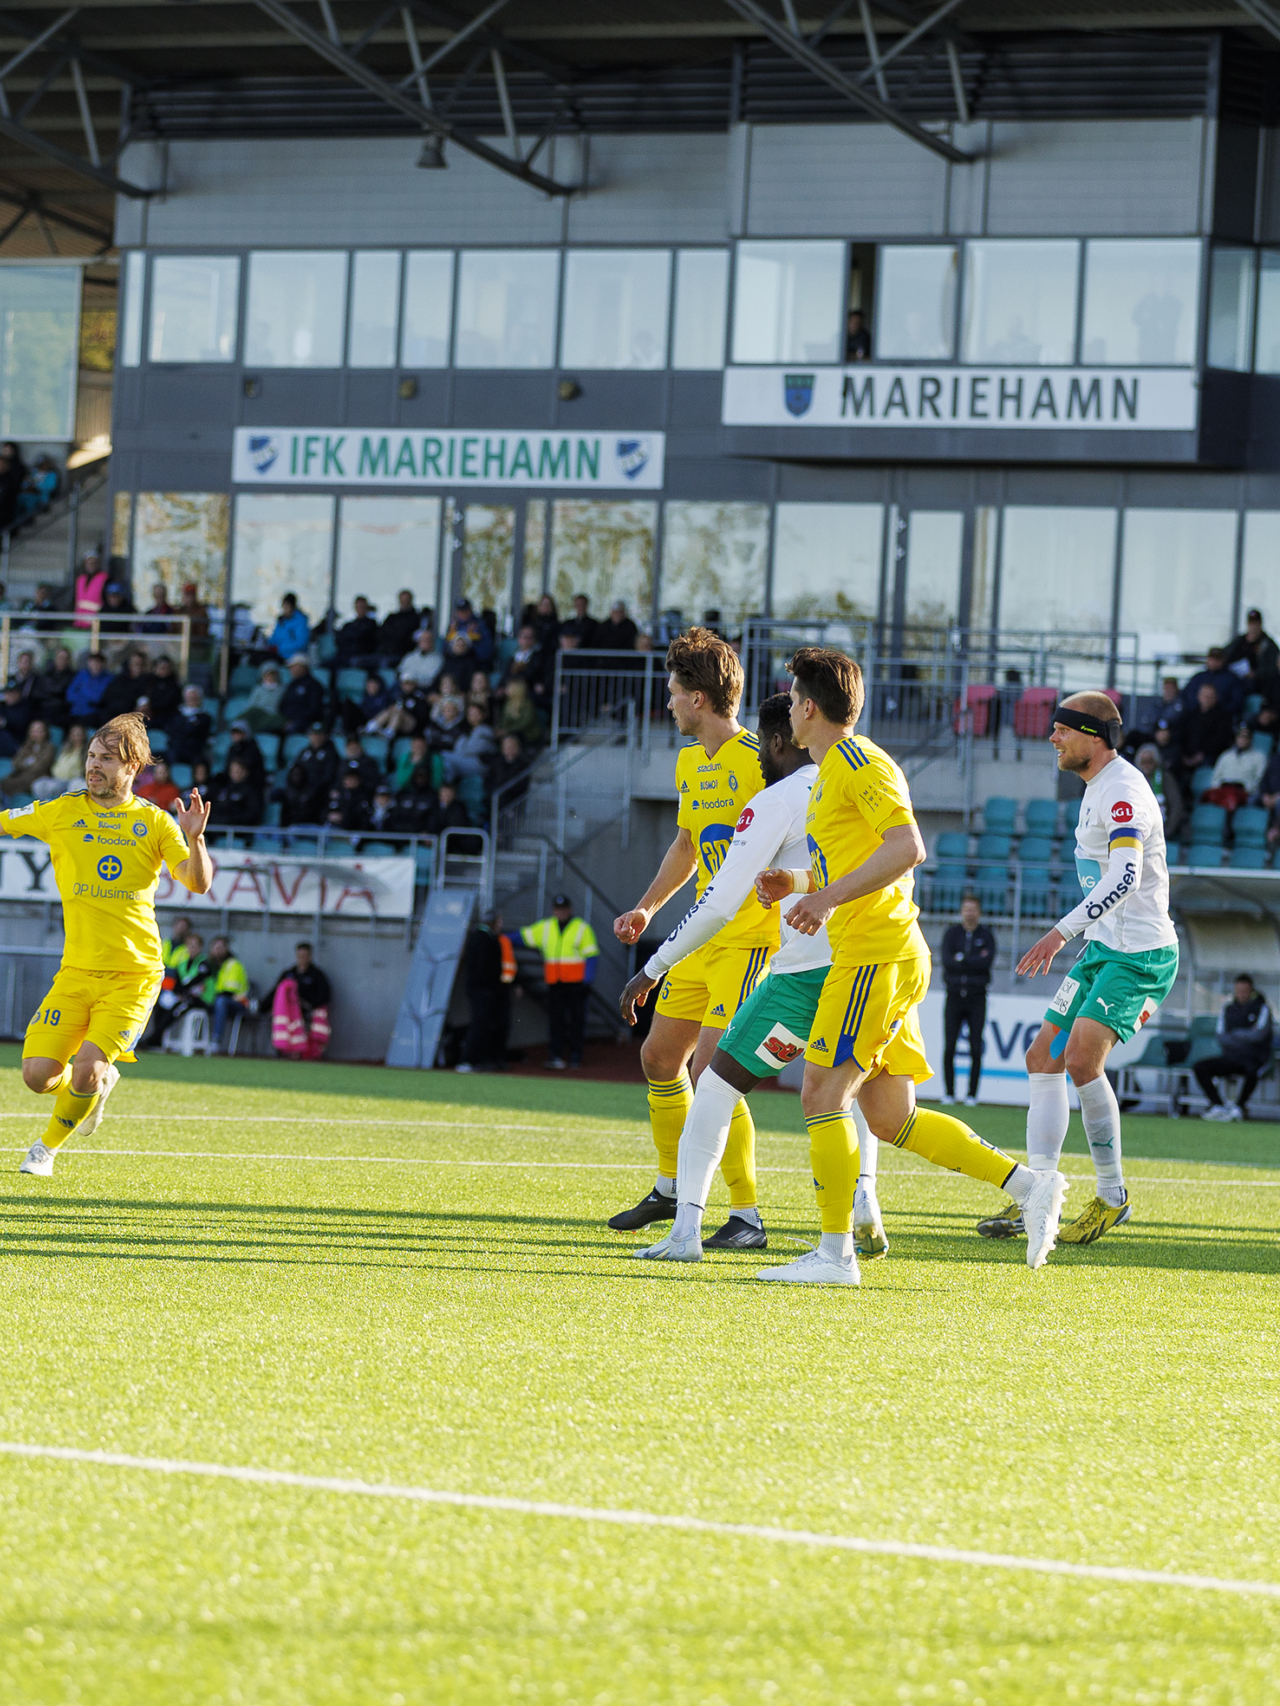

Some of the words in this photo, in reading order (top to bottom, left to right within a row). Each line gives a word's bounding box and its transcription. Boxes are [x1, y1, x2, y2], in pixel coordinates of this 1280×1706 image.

[841, 376, 1139, 421] MARIEHAMN
[291, 436, 346, 476] IFK
[358, 436, 600, 479] MARIEHAMN
[697, 763, 722, 773] stadium
[701, 798, 734, 809] foodora
[97, 835, 136, 846] foodora
[73, 883, 89, 896] OP
[91, 885, 140, 901] Uusimaa
[1085, 862, 1136, 920] Ömsen
[43, 1008, 61, 1026] 19
